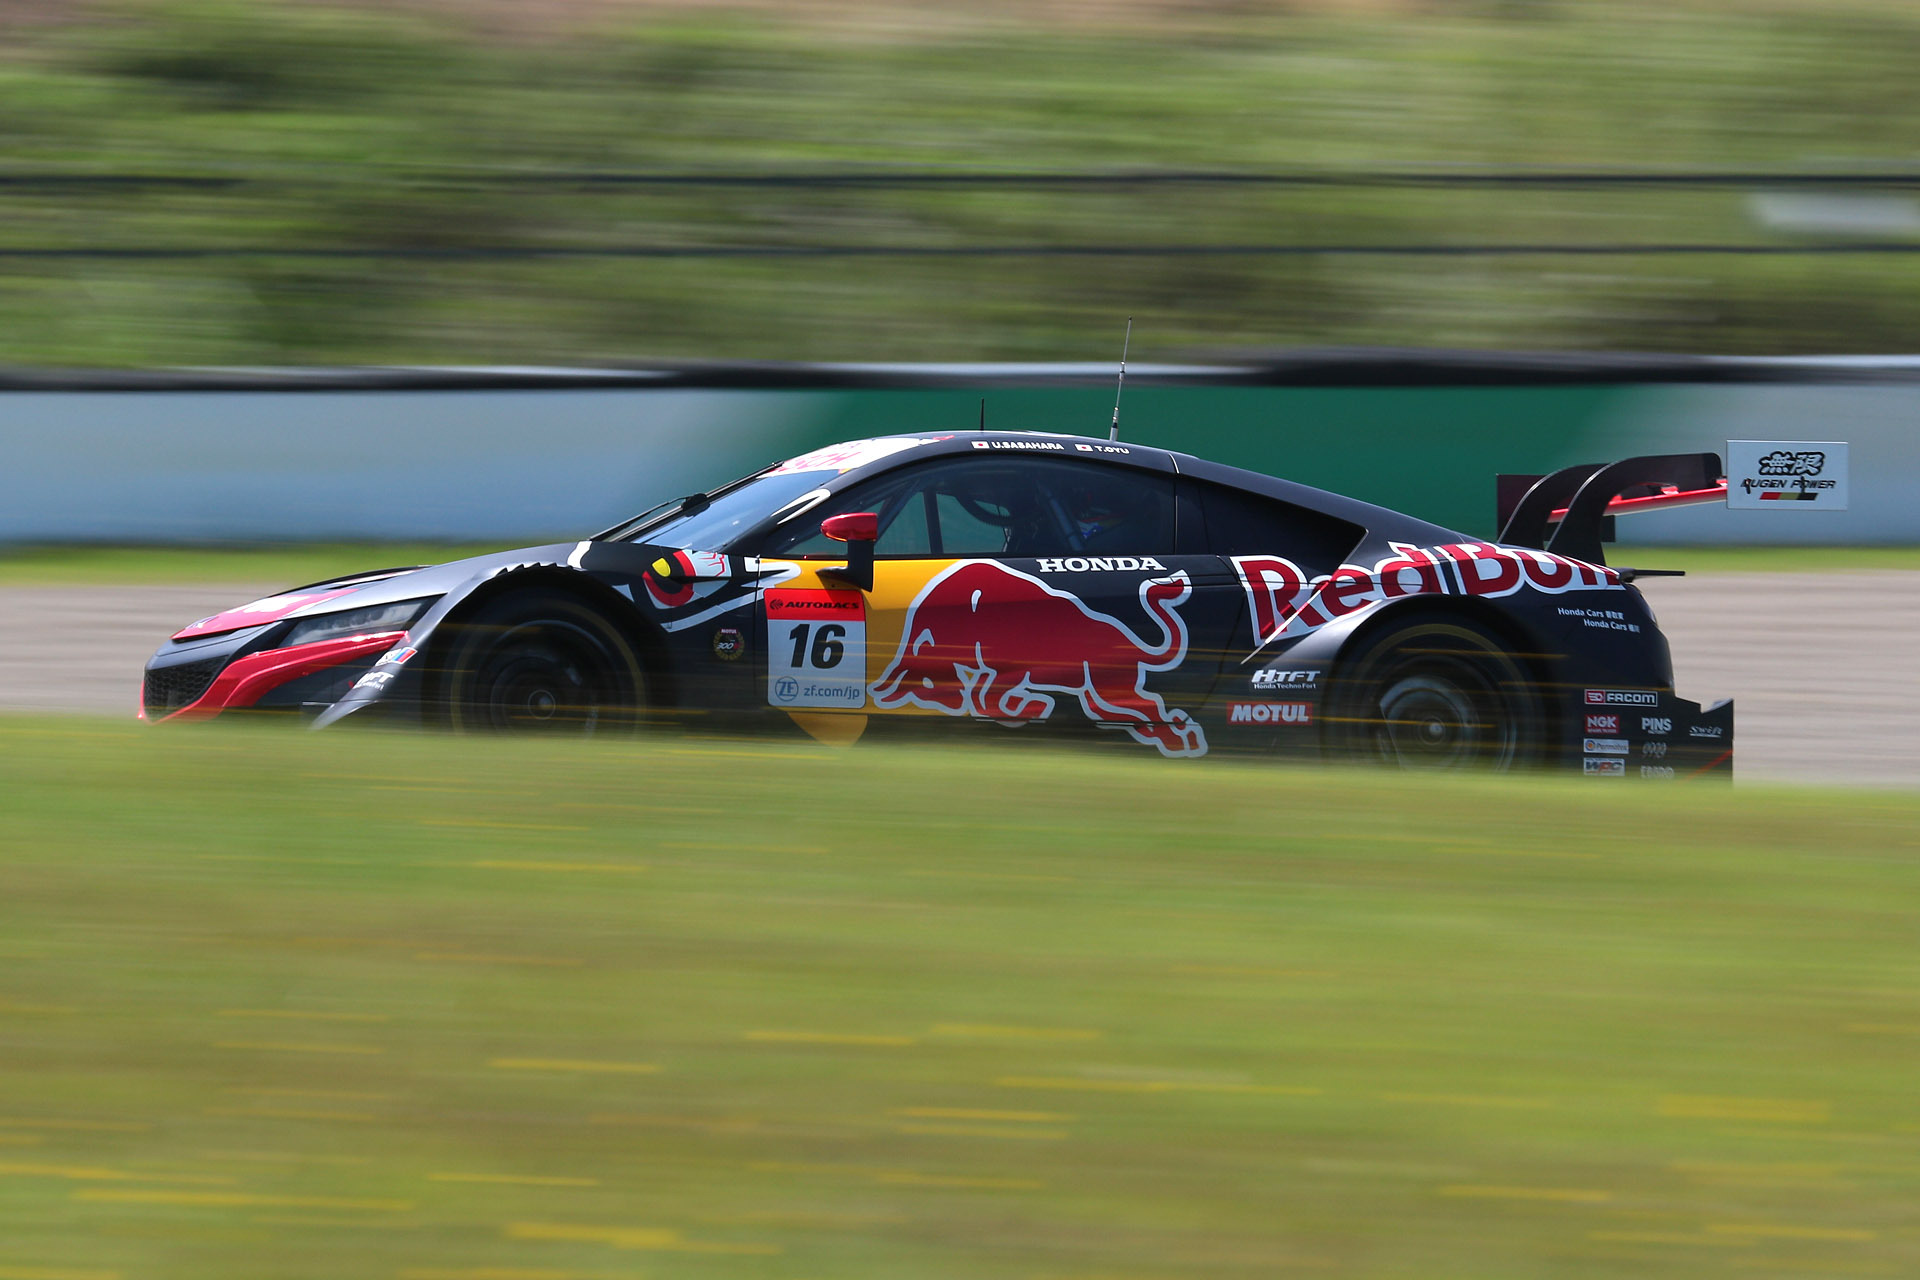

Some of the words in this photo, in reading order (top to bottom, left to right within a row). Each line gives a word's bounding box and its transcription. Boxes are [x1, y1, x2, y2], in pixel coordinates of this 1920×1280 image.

[992, 442, 1064, 450] U.SASAHARA
[1094, 445, 1130, 454] T.OYU
[1759, 451, 1825, 476] 無限
[1036, 557, 1167, 573] HONDA
[1230, 540, 1449, 647] Red
[784, 601, 860, 609] AUTOBACS
[1557, 608, 1585, 617] Honda
[1586, 609, 1604, 618] Cars
[1584, 619, 1610, 629] Honda
[1610, 621, 1628, 631] Cars
[789, 623, 846, 669] 16
[1251, 669, 1321, 683] HTFT
[803, 684, 860, 700] zf.com/jp
[1607, 693, 1655, 703] FACOM
[1231, 704, 1309, 723] MOTUL
[1587, 716, 1617, 728] NGK
[1641, 717, 1673, 731] PINS
